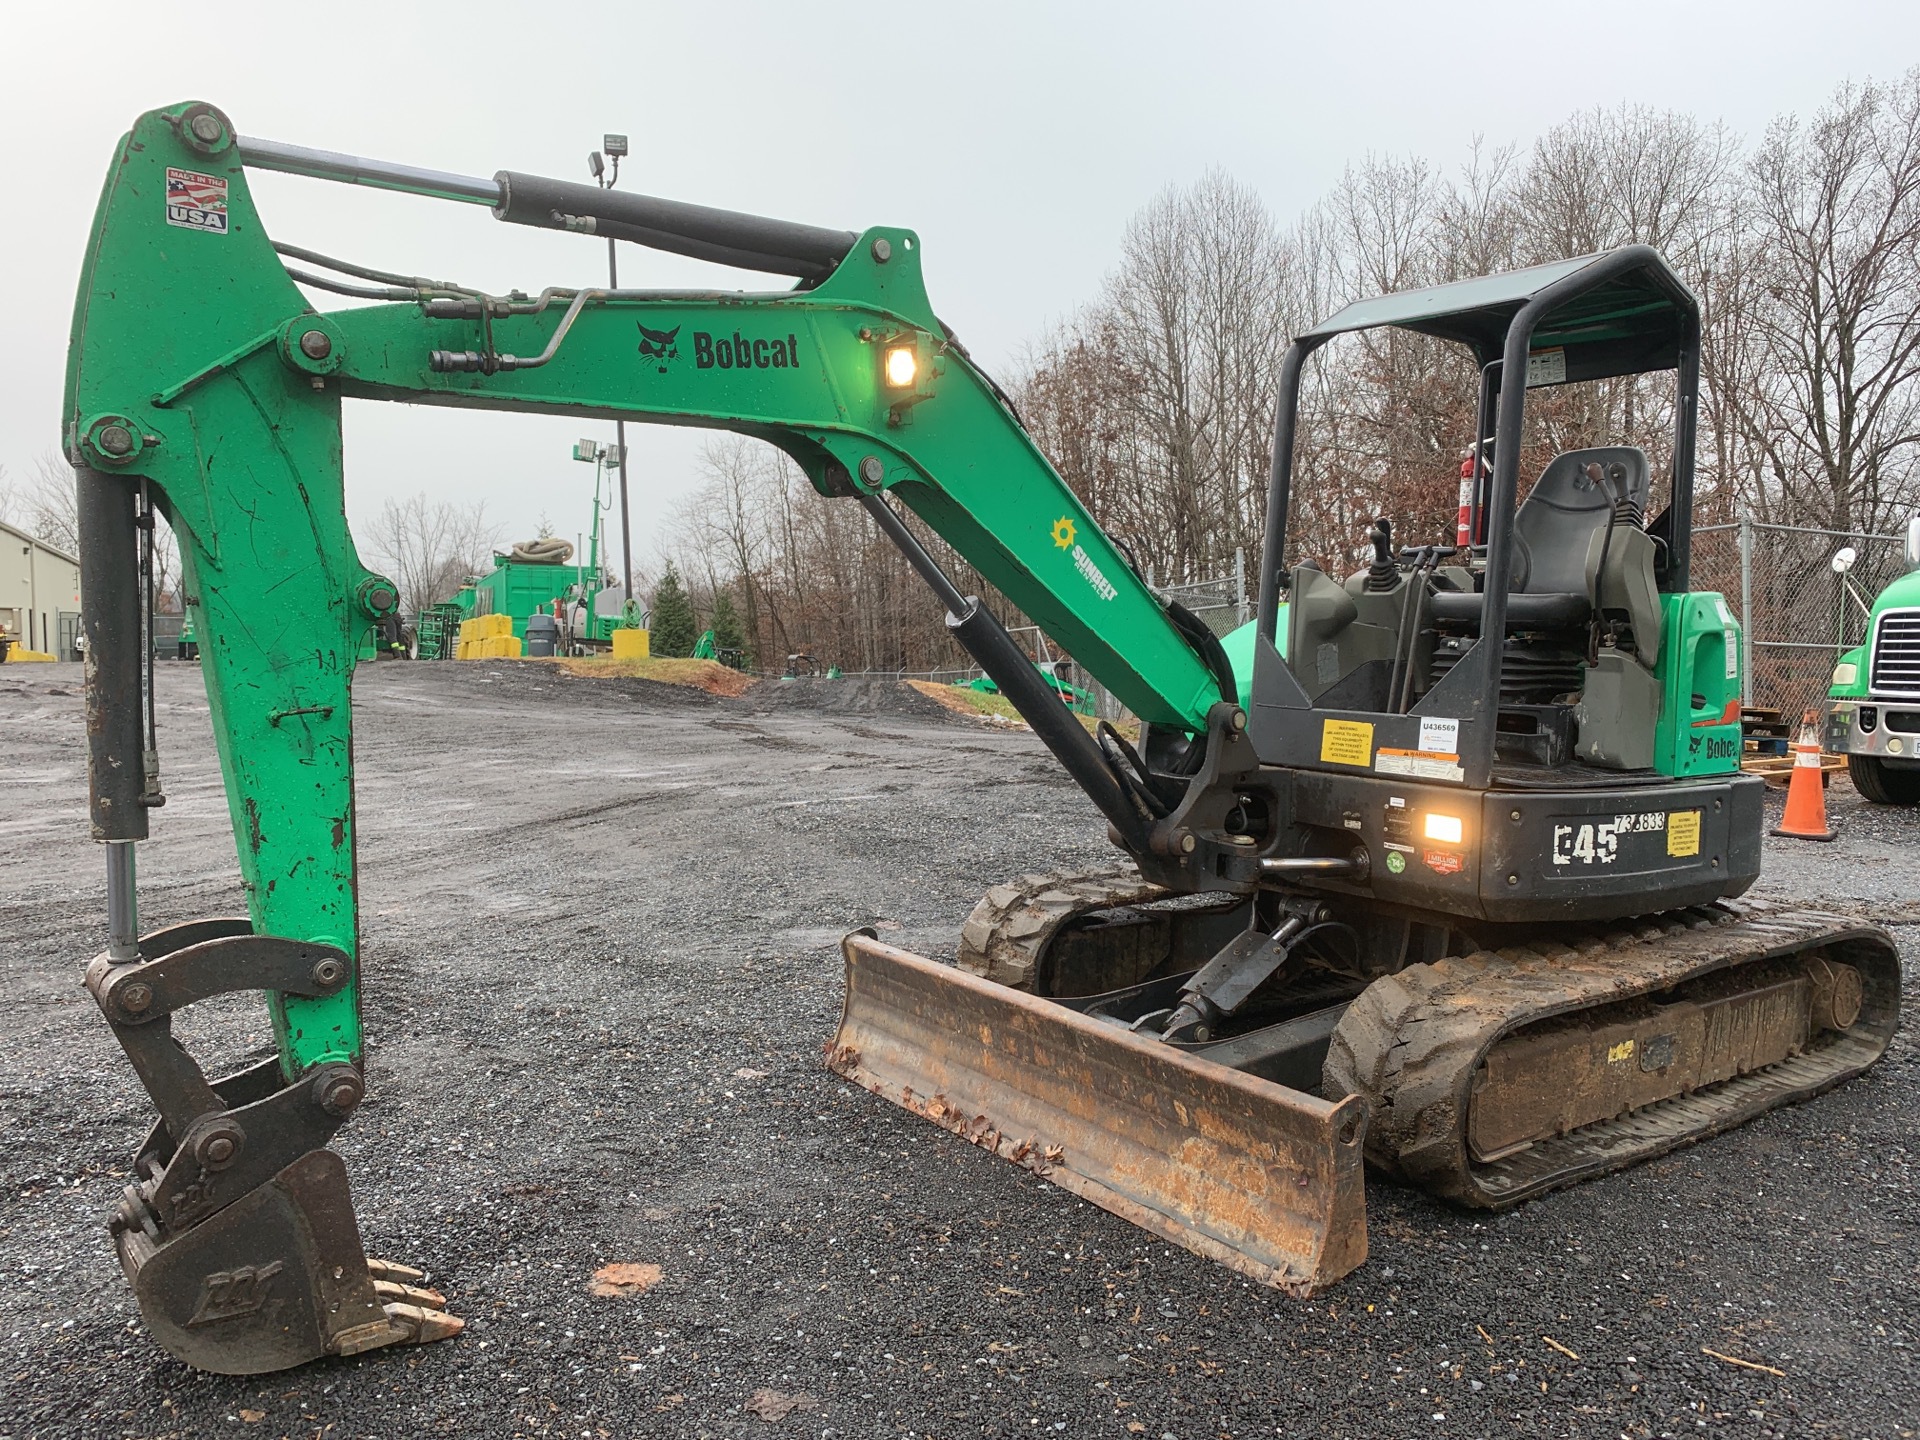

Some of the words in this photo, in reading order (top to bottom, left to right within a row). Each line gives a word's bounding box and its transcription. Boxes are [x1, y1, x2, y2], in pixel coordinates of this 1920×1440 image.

[170, 206, 223, 228] USA
[693, 331, 800, 369] Bobcat
[1071, 544, 1118, 602] SUNBELT
[1074, 561, 1106, 600] RENTALS
[1423, 723, 1456, 732] U436569
[1410, 751, 1436, 759] WARNING
[1553, 824, 1618, 865] E45
[1430, 854, 1458, 866] MILLION
